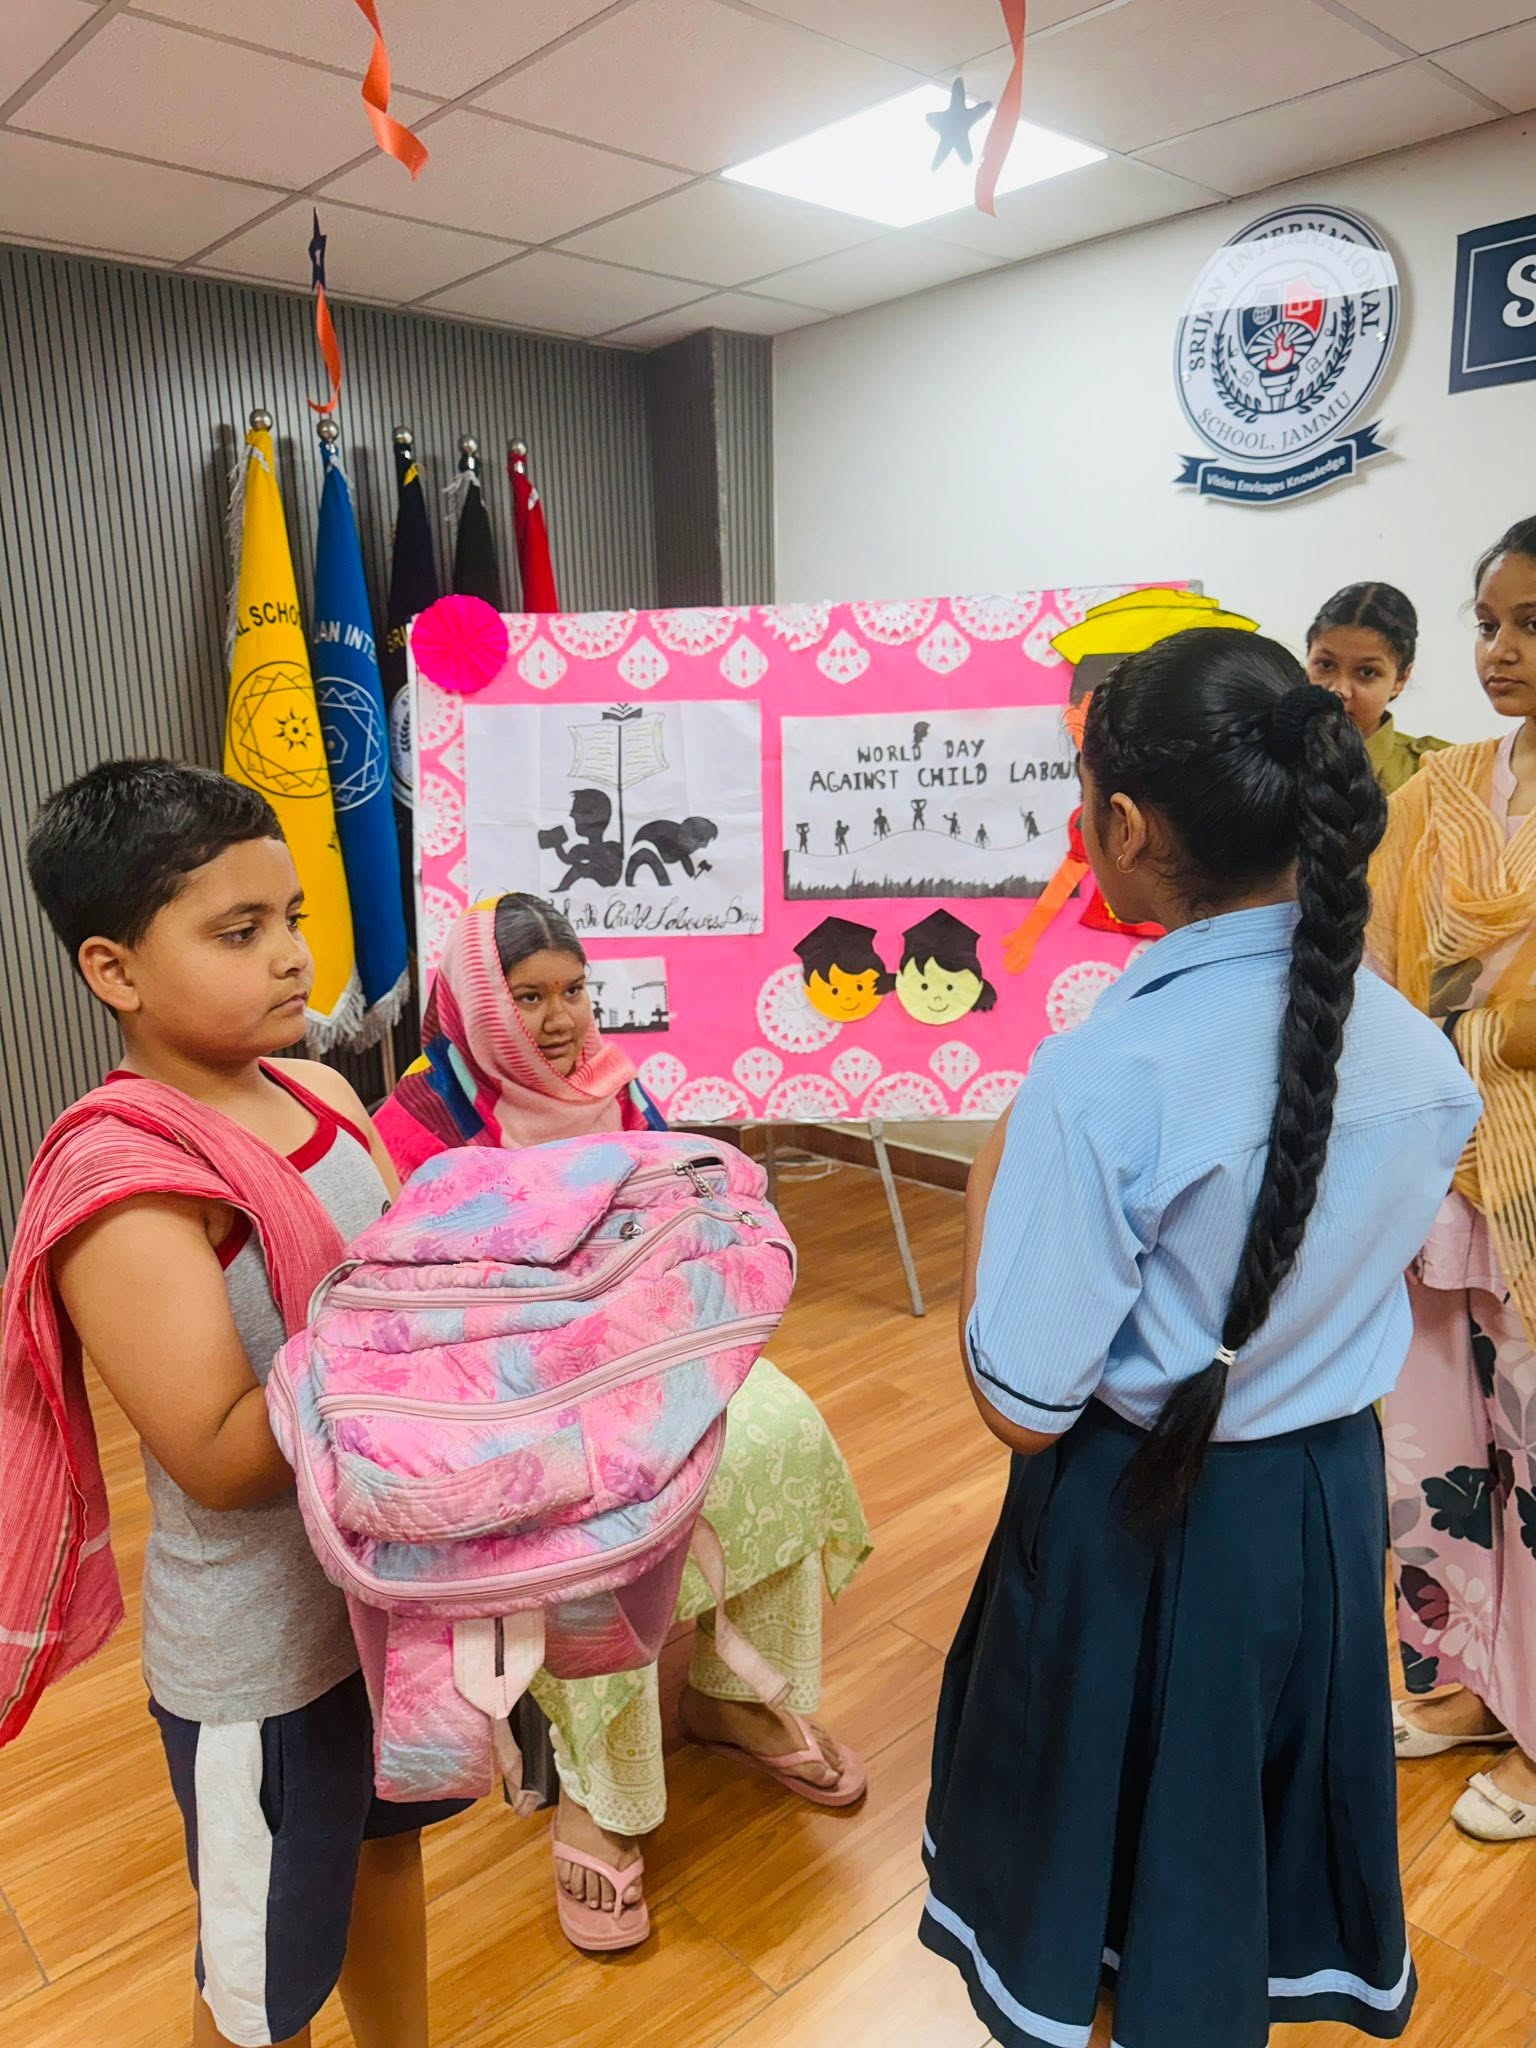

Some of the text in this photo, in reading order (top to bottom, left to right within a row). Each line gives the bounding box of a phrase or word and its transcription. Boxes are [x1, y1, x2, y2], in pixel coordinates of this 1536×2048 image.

[1190, 278, 1227, 371] SRIJAN
[1281, 391, 1351, 449] JAMMU
[1206, 456, 1347, 495] Vision Envisages Knowledge
[249, 602, 302, 627] SCHO
[857, 738, 986, 764] WORLD DAY
[809, 760, 1077, 793] AGAINST CHILD LABOU
[725, 895, 761, 936] Day
